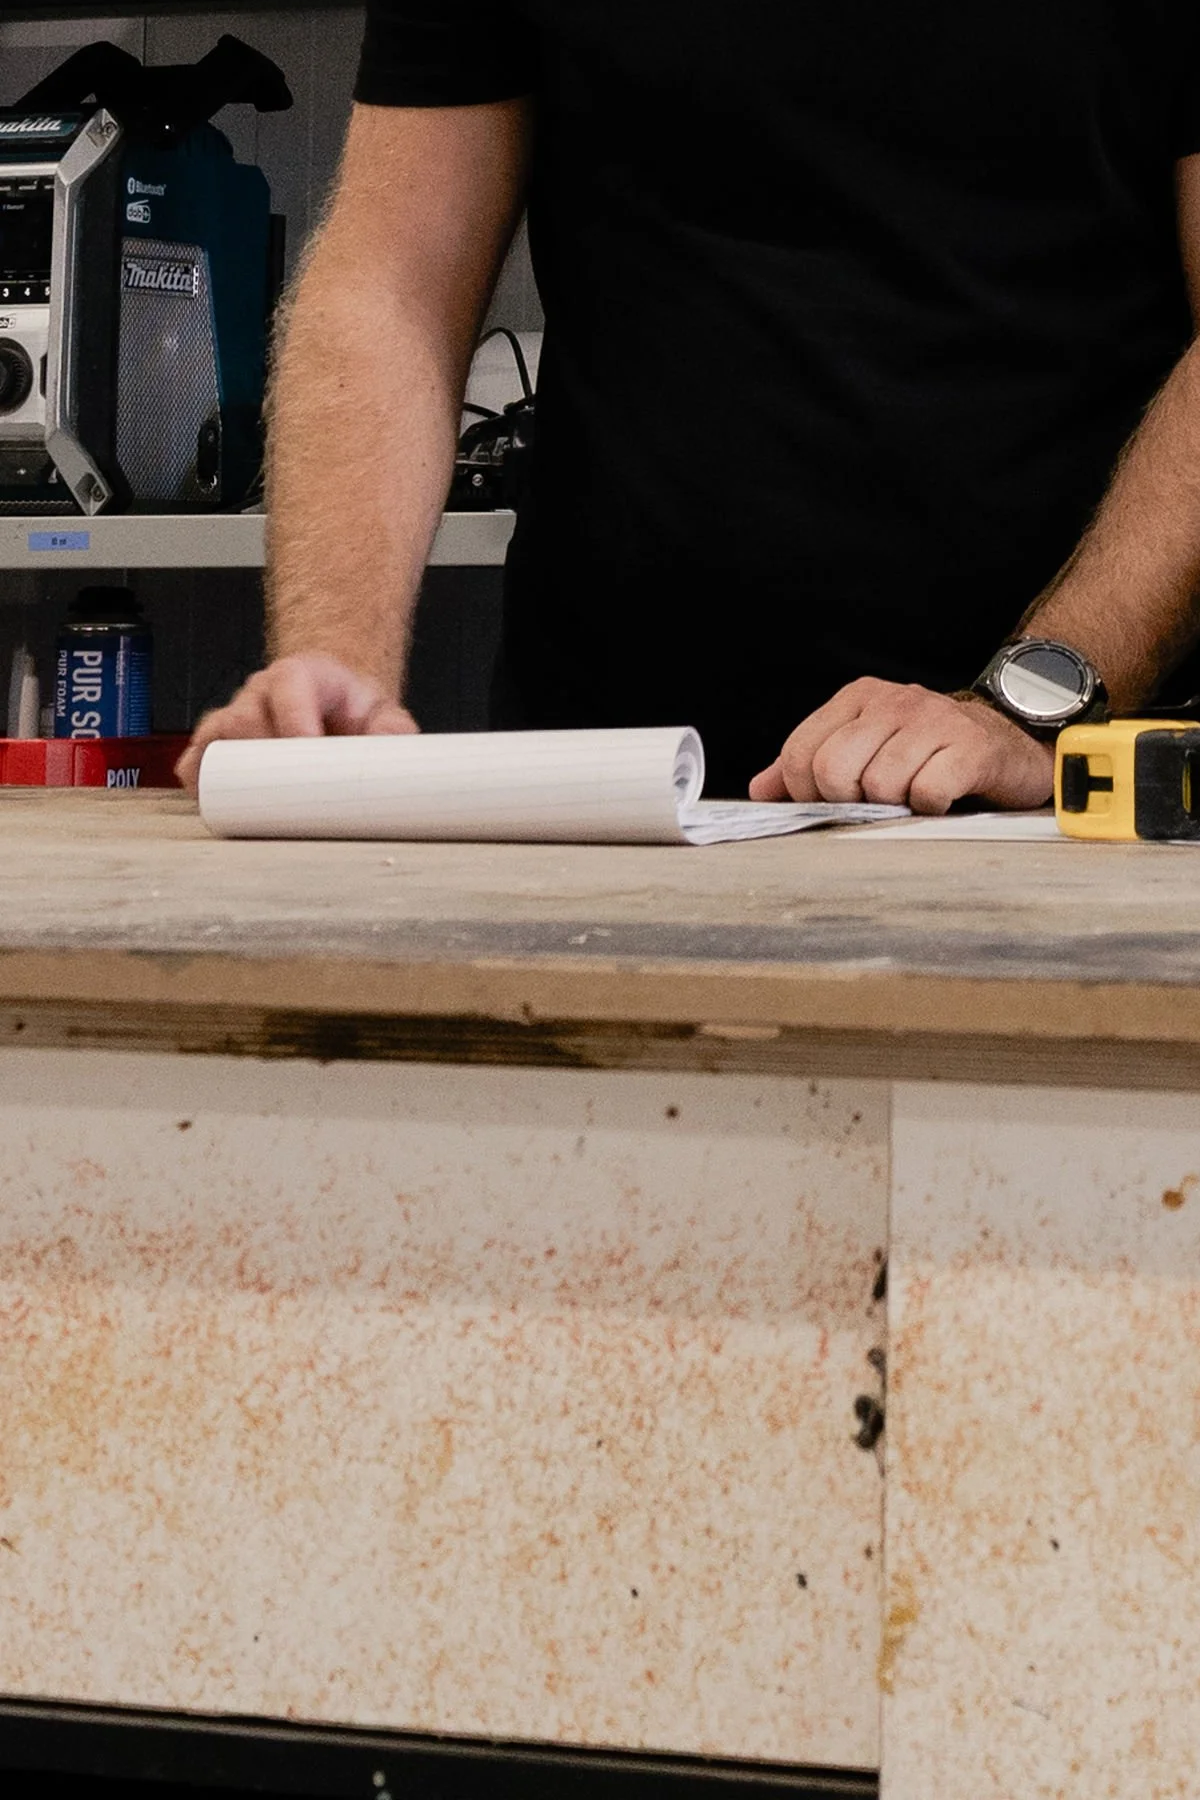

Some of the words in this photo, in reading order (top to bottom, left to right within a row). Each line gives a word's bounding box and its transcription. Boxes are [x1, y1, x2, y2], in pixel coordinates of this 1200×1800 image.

[0, 117, 62, 133] akita
[126, 262, 195, 292] Makita
[57, 649, 68, 676] PUR
[71, 650, 103, 703] PUR
[56, 680, 67, 717] FOAM
